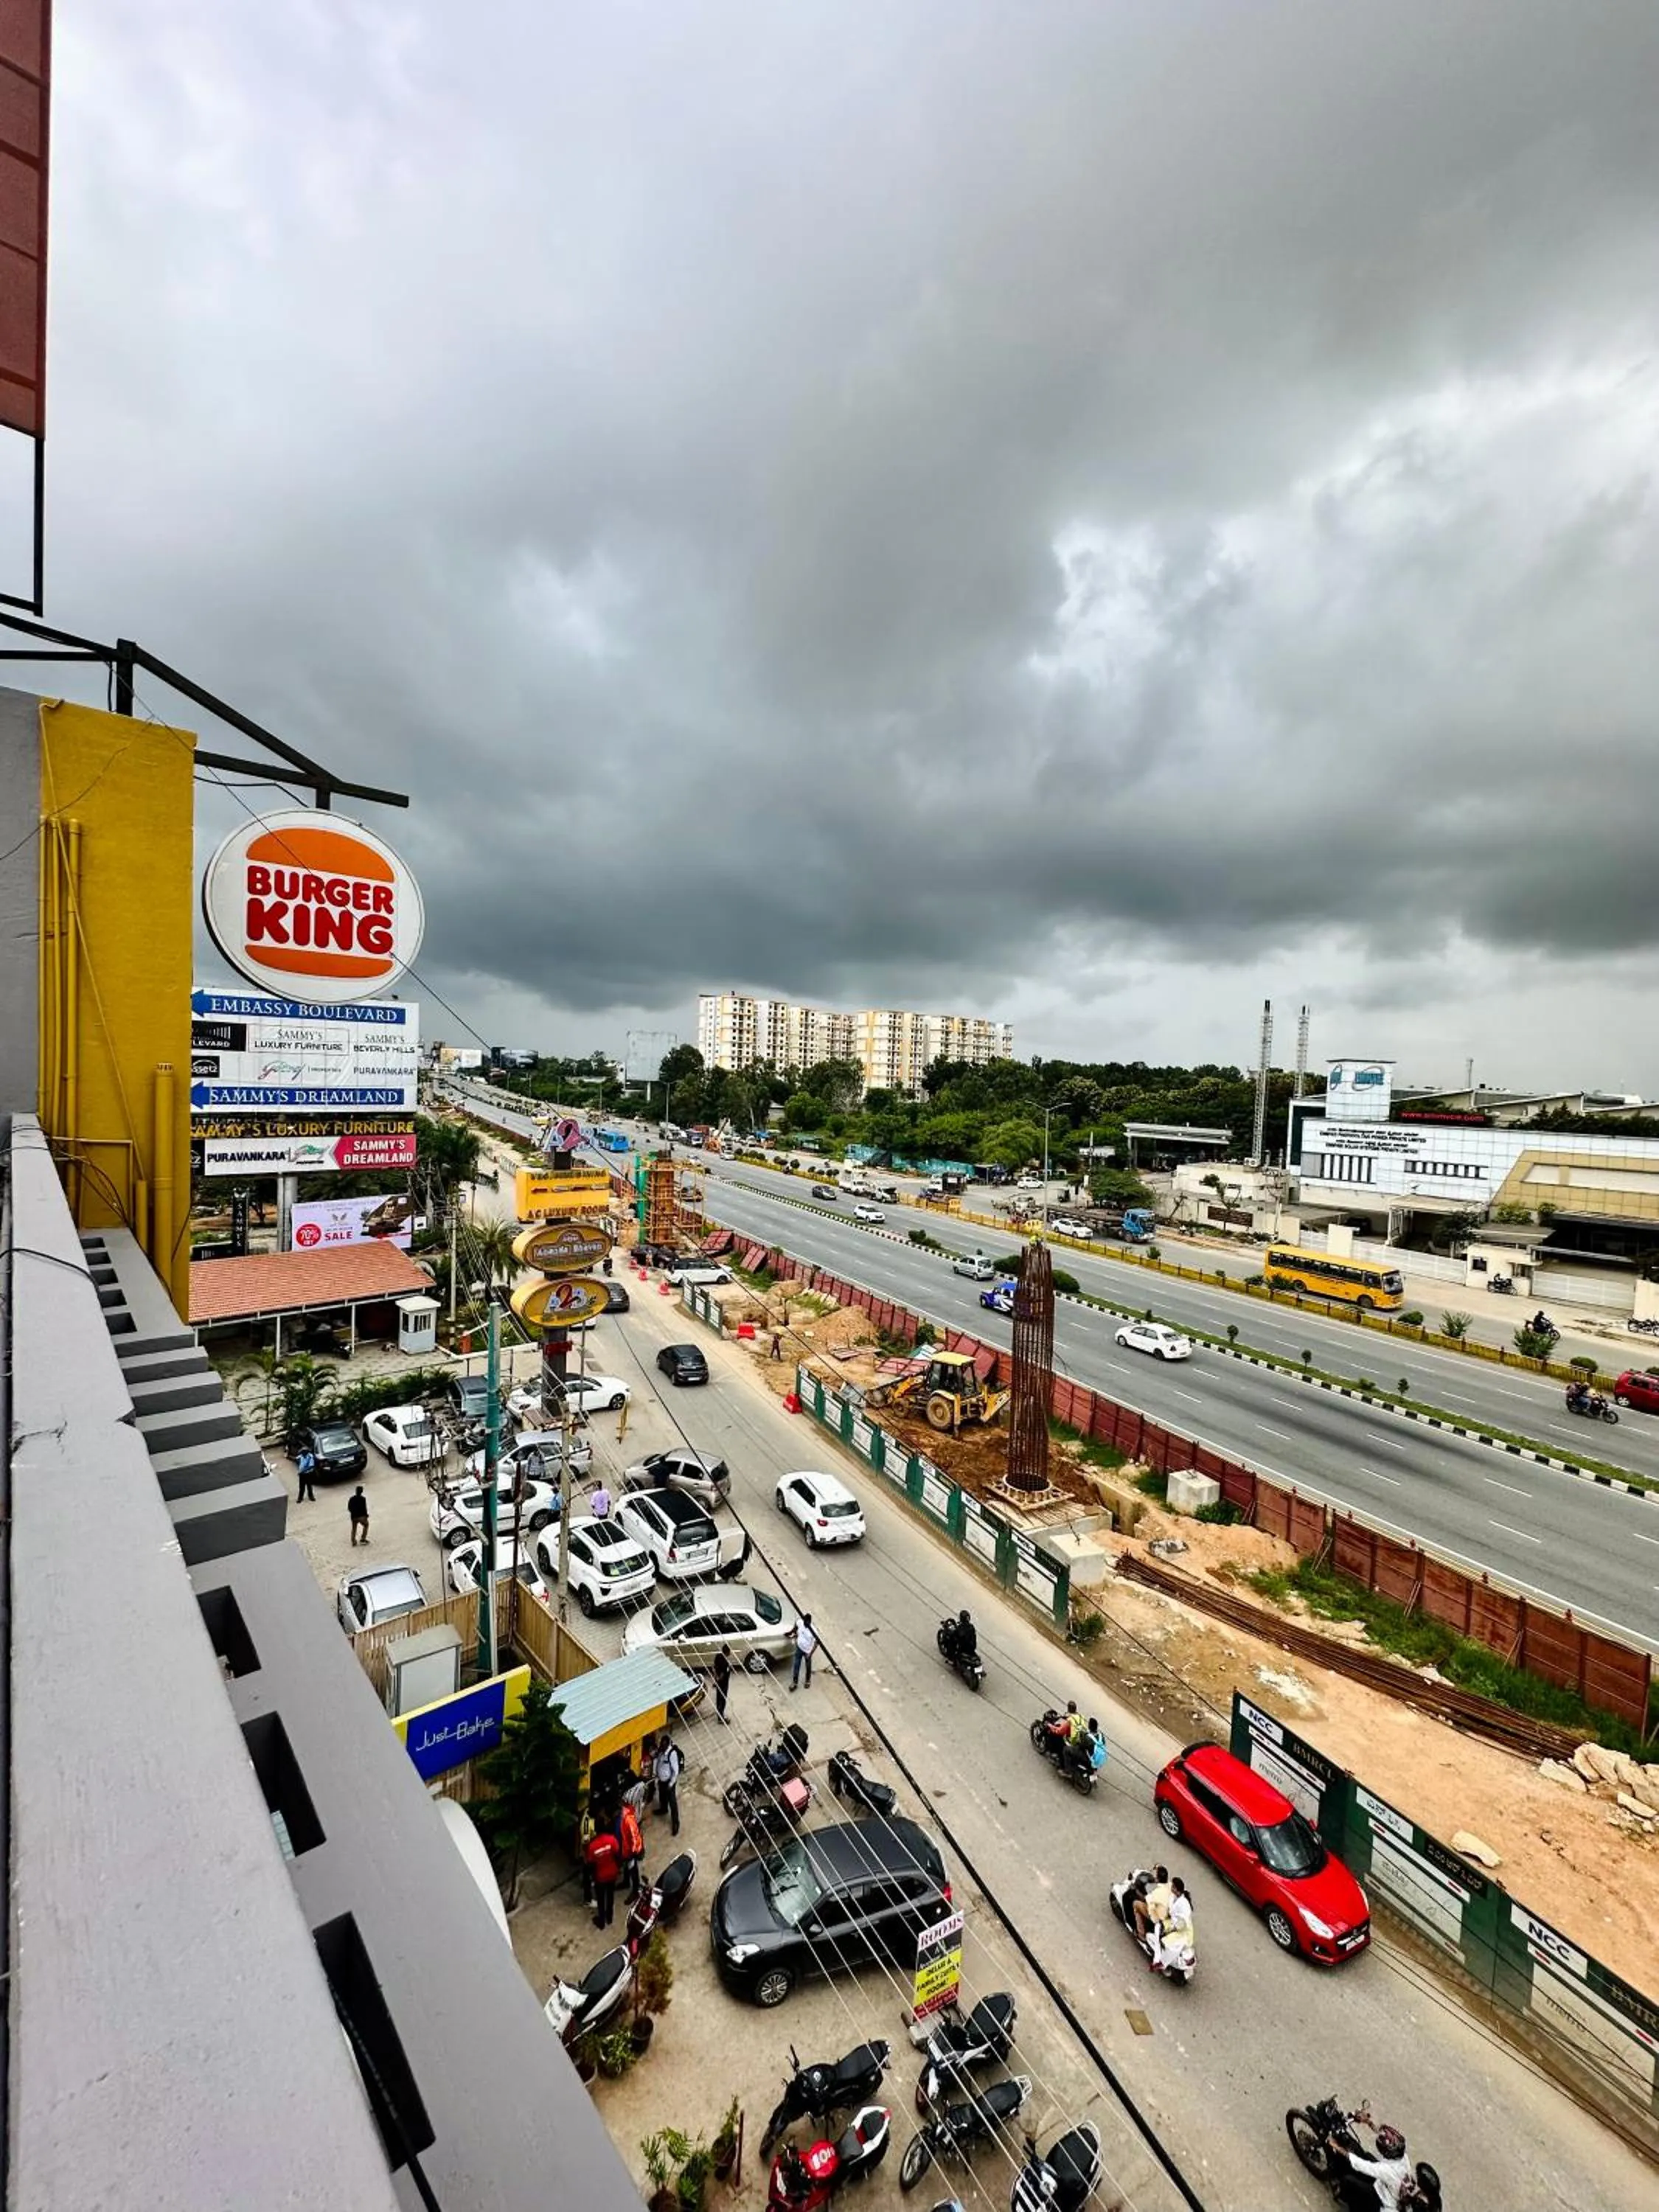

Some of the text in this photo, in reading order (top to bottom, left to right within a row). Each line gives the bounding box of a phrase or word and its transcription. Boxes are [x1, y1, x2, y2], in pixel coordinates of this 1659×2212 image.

[247, 865, 394, 914] BURGER
[246, 897, 394, 955] KING
[211, 998, 397, 1021] EMBASSY BOULEVARD
[254, 1040, 343, 1051] LUXURY FURNITURE
[353, 1044, 415, 1054] BEVERLY HILLS
[209, 1089, 397, 1102] SAMMY'S DREAMLAND
[265, 1122, 330, 1137] LUXURY
[334, 1120, 414, 1135] FURNITURE
[353, 1139, 406, 1151] SAMMY'S
[207, 1151, 286, 1162] PURAVANKARA
[343, 1152, 414, 1165] DREAMLAND
[324, 1231, 354, 1241] SALE
[457, 1715, 495, 1740] Bake
[1248, 1709, 1273, 1733] NCC
[1293, 1741, 1335, 1783] BMRCL
[921, 1917, 962, 1947] ROOMS
[1528, 1921, 1570, 1961] NCC
